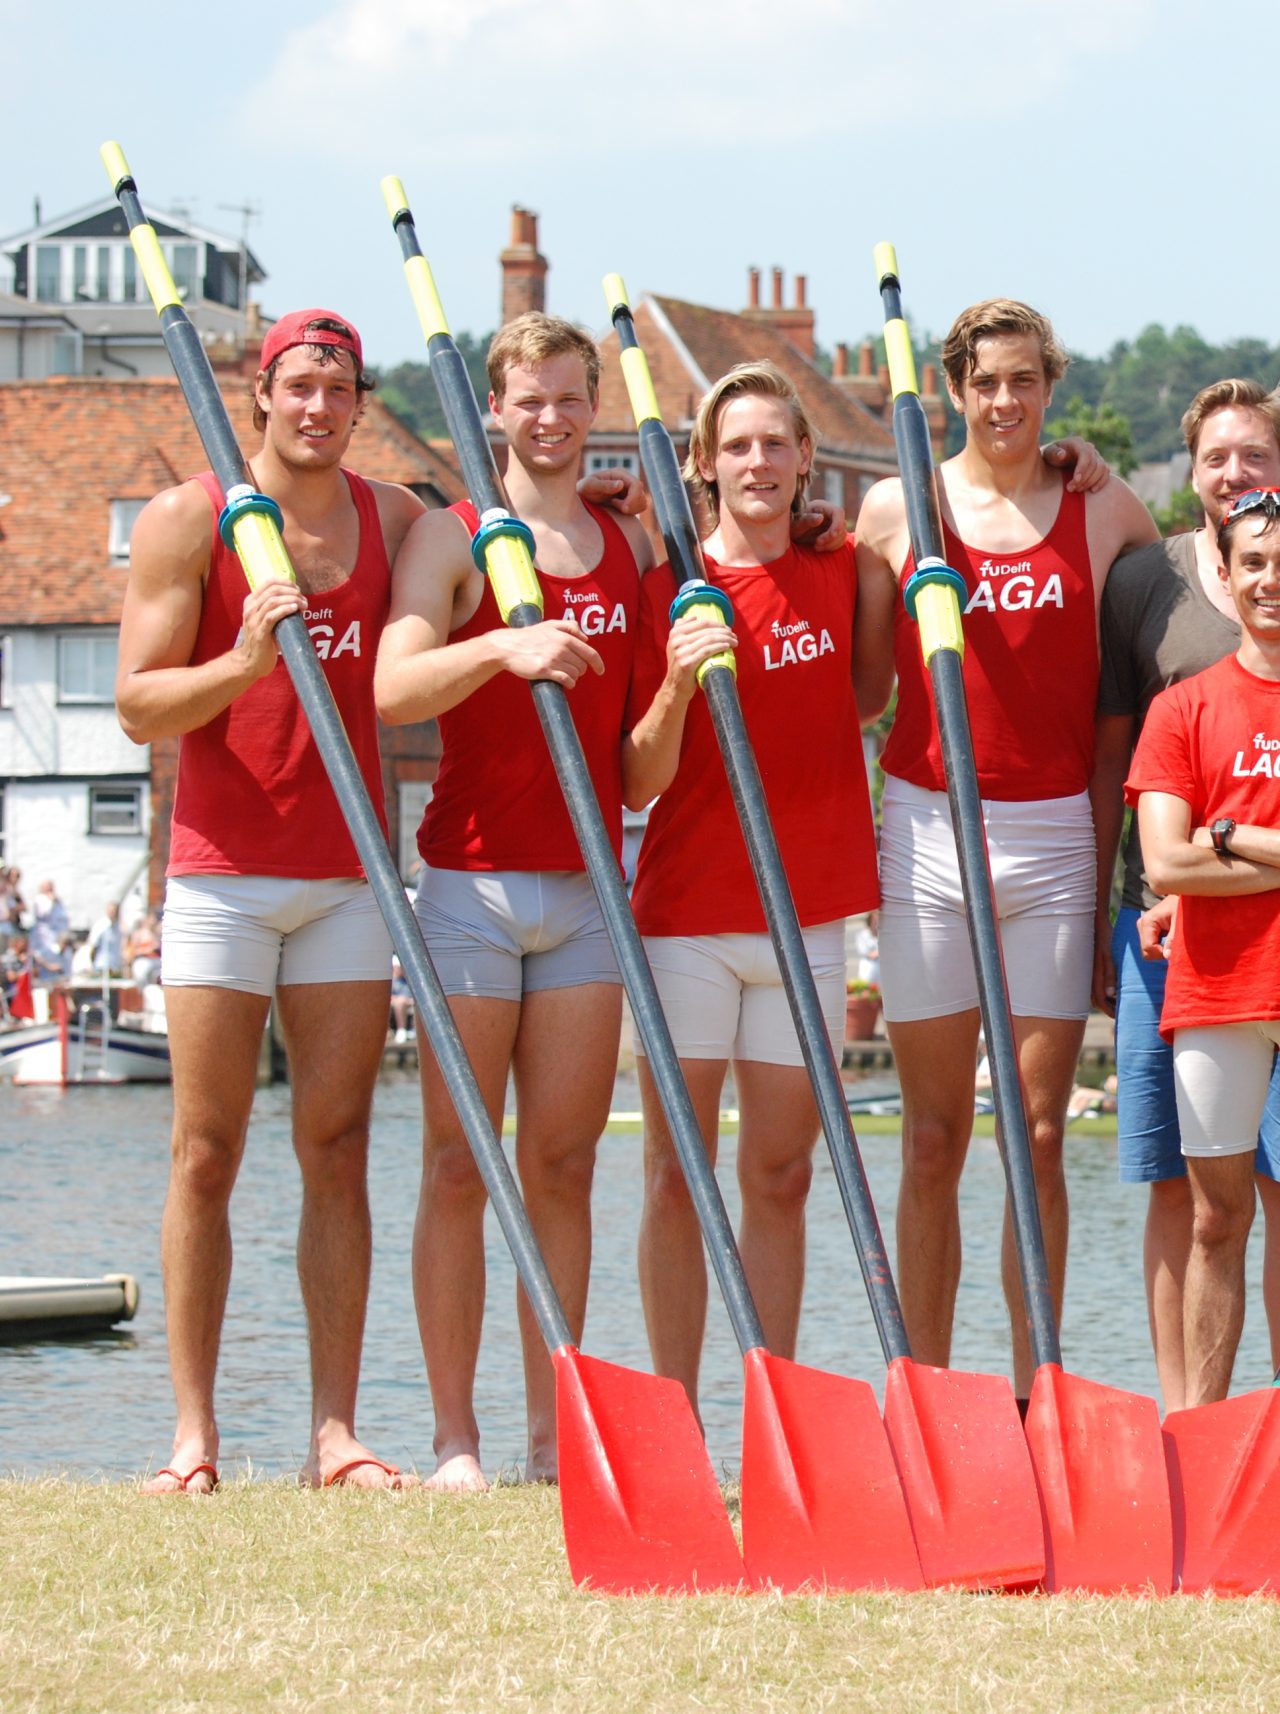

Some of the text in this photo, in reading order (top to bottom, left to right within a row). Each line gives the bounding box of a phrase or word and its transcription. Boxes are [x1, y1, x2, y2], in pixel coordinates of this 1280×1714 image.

[963, 574, 1064, 614] AGA
[302, 608, 334, 620] Delft
[562, 603, 627, 635] GA
[763, 628, 835, 671] LAGA
